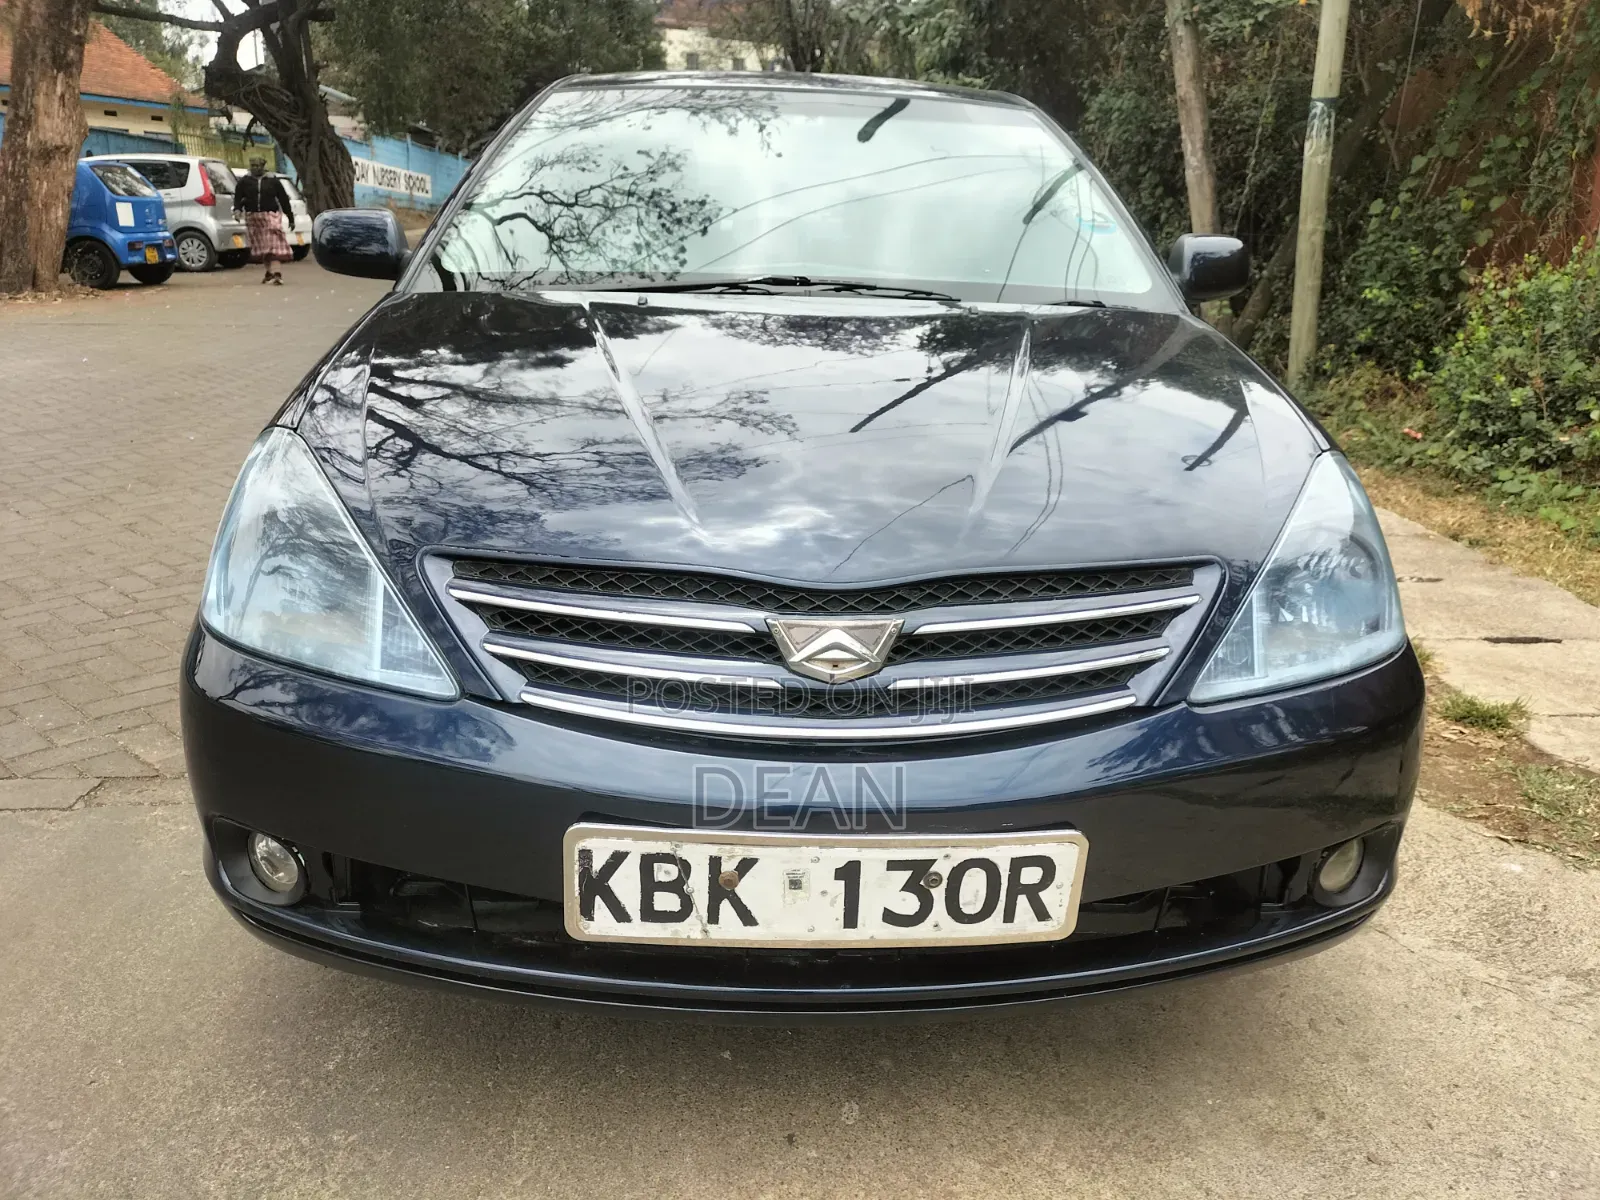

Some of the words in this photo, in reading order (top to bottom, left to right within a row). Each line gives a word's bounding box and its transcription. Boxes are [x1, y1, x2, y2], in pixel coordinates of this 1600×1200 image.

[373, 164, 402, 188] NURSERY
[404, 172, 429, 194] SCHOOL
[577, 849, 760, 927] KBK
[833, 854, 1057, 929] 130R
